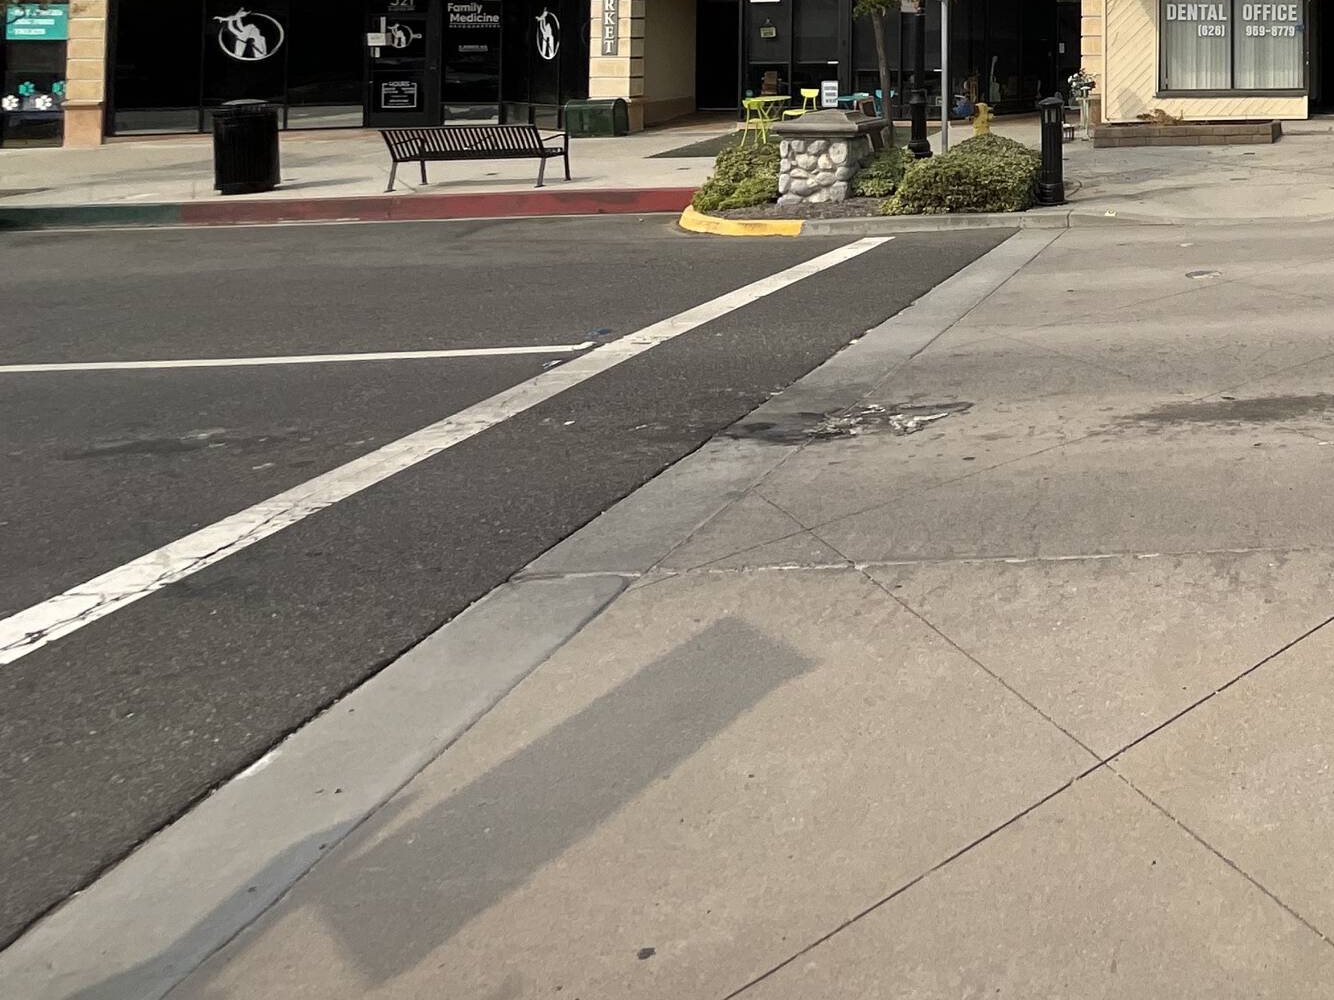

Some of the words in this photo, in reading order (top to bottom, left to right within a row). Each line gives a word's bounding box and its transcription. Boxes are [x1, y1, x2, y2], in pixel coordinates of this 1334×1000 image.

[447, 2, 483, 14] Family
[1166, 4, 1227, 21] DENTAL
[1242, 4, 1297, 21] OFFICE
[450, 12, 500, 22] Medicine
[1198, 24, 1225, 37] (626)
[1246, 25, 1295, 37] 969-8779
